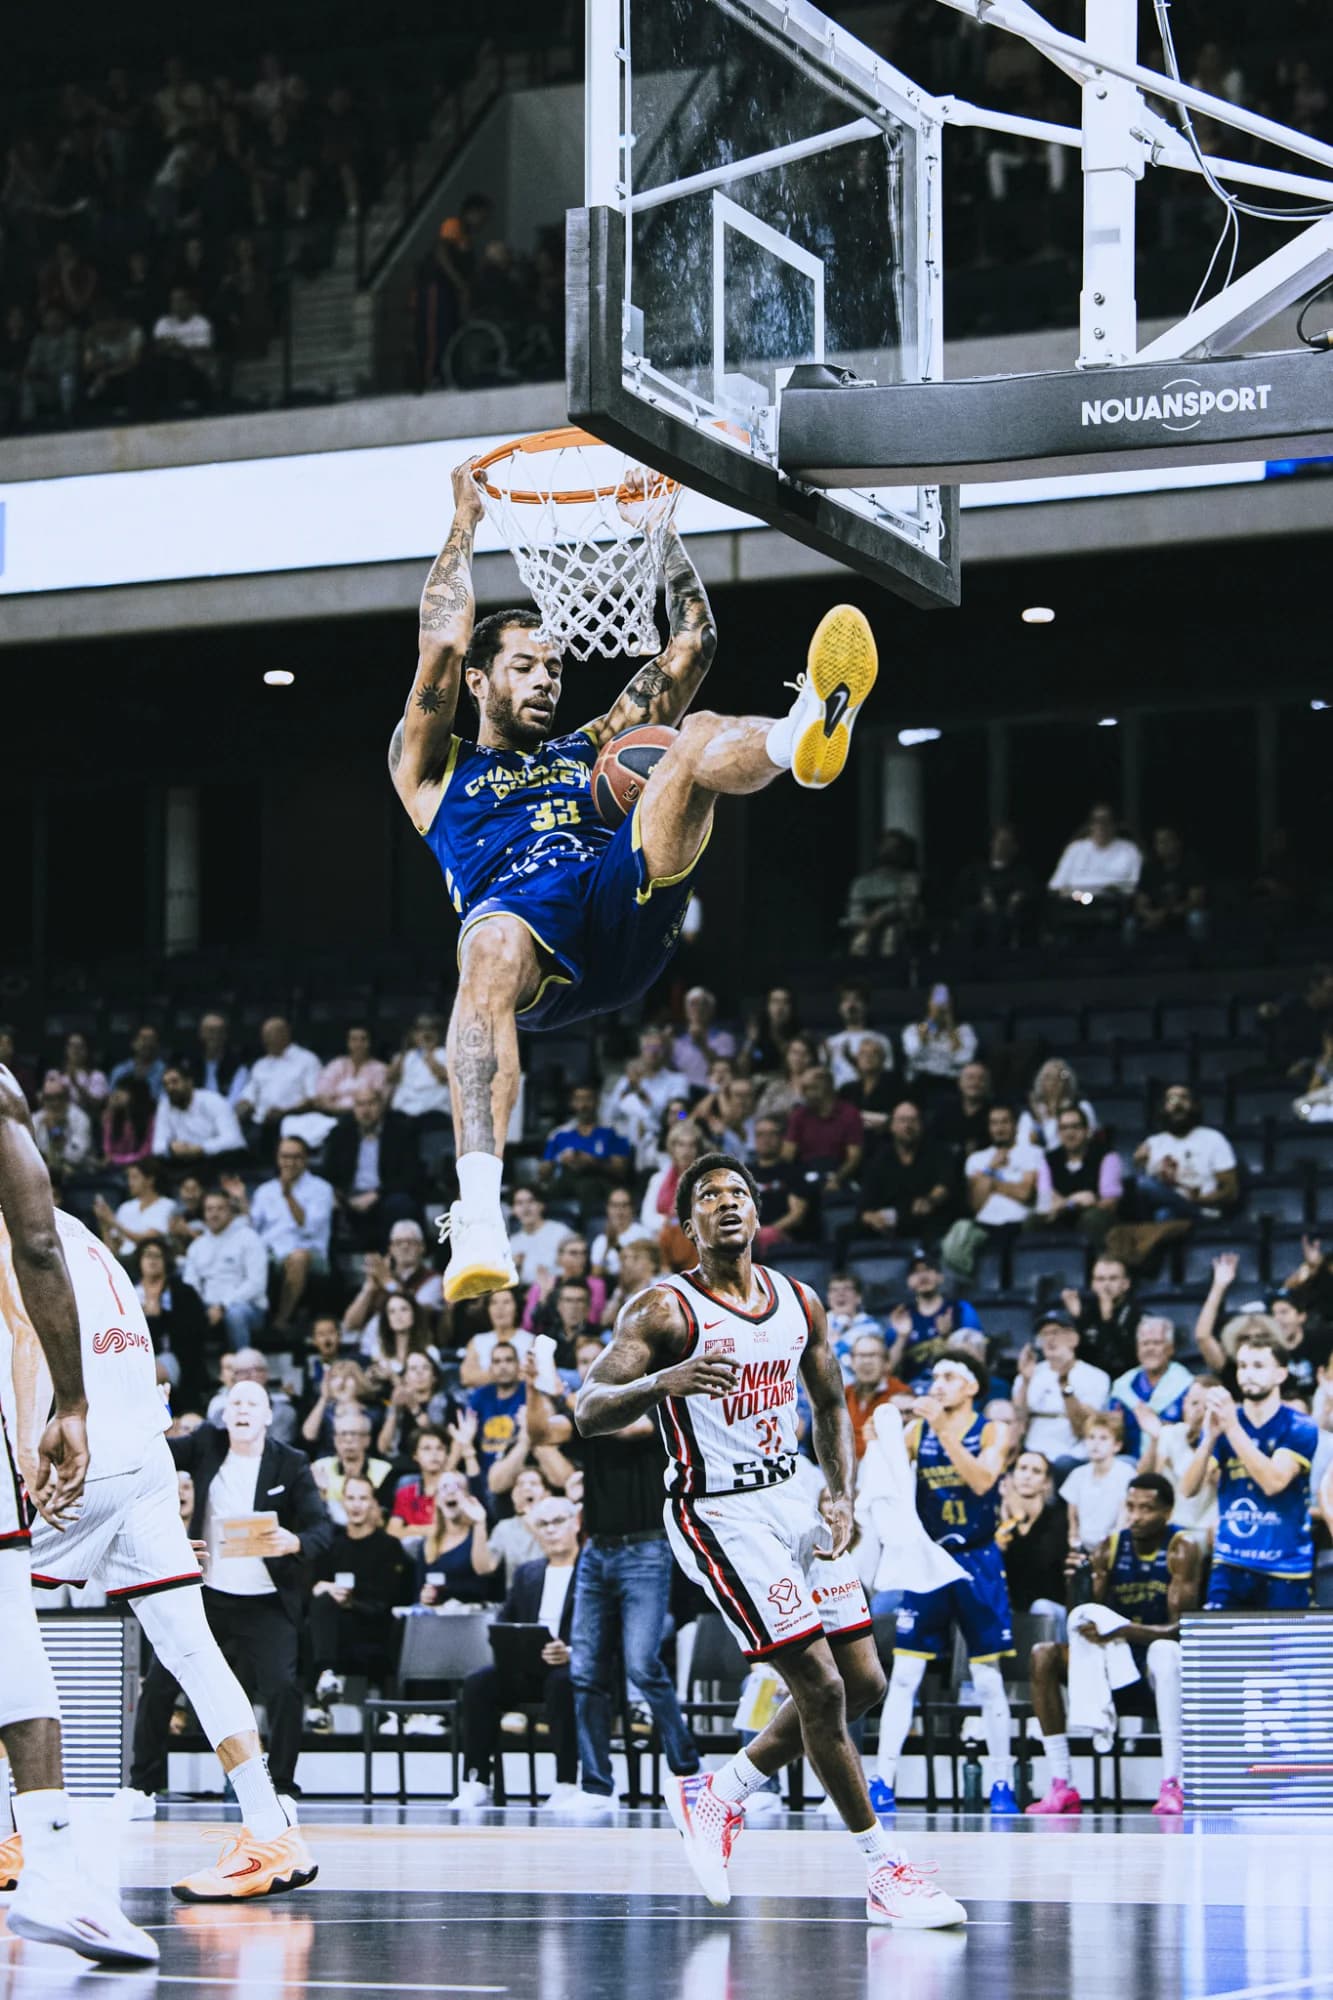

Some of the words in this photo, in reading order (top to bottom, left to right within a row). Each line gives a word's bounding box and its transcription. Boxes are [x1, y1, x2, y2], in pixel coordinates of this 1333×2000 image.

[1081, 384, 1272, 426] NOUANSPORT
[526, 798, 581, 831] 33
[710, 1359, 791, 1401] NAIN
